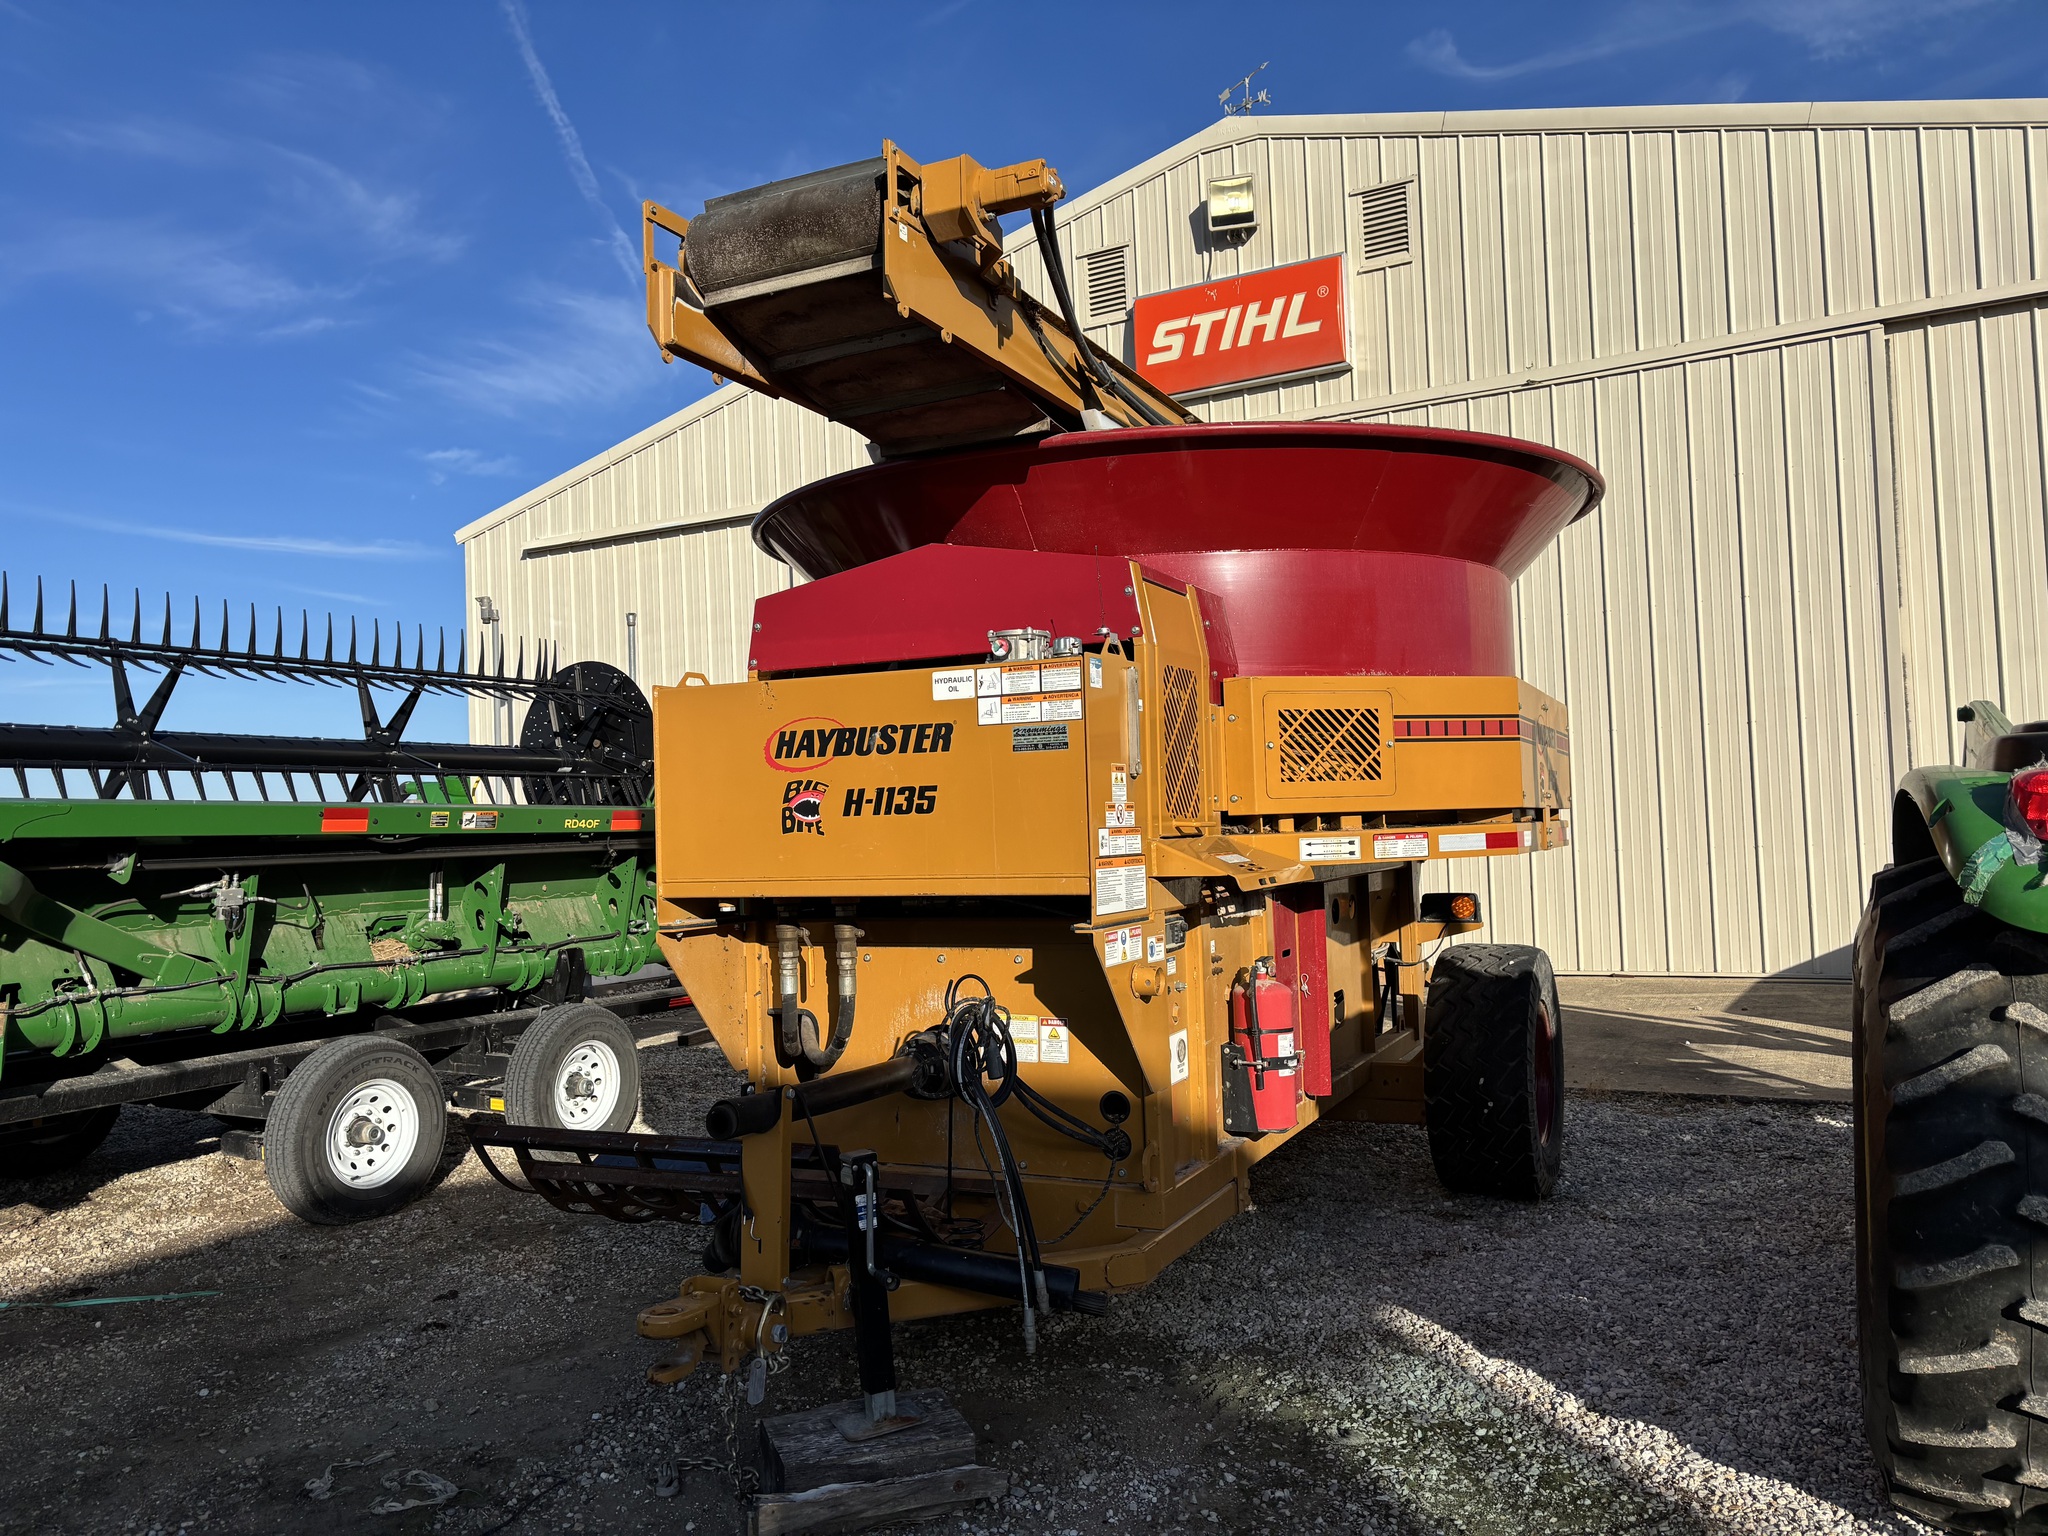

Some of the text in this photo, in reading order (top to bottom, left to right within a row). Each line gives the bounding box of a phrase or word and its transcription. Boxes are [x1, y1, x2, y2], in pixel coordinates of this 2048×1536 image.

[1146, 291, 1322, 365] STIHL
[934, 675, 973, 685] HYDRAULIC
[947, 685, 960, 693] OIL
[775, 722, 954, 760] HAYBUSTER
[842, 785, 938, 817] H-1135
[564, 819, 601, 829] RD40F
[781, 806, 825, 836] BITE
[317, 1056, 420, 1116] MASTERTRACK
